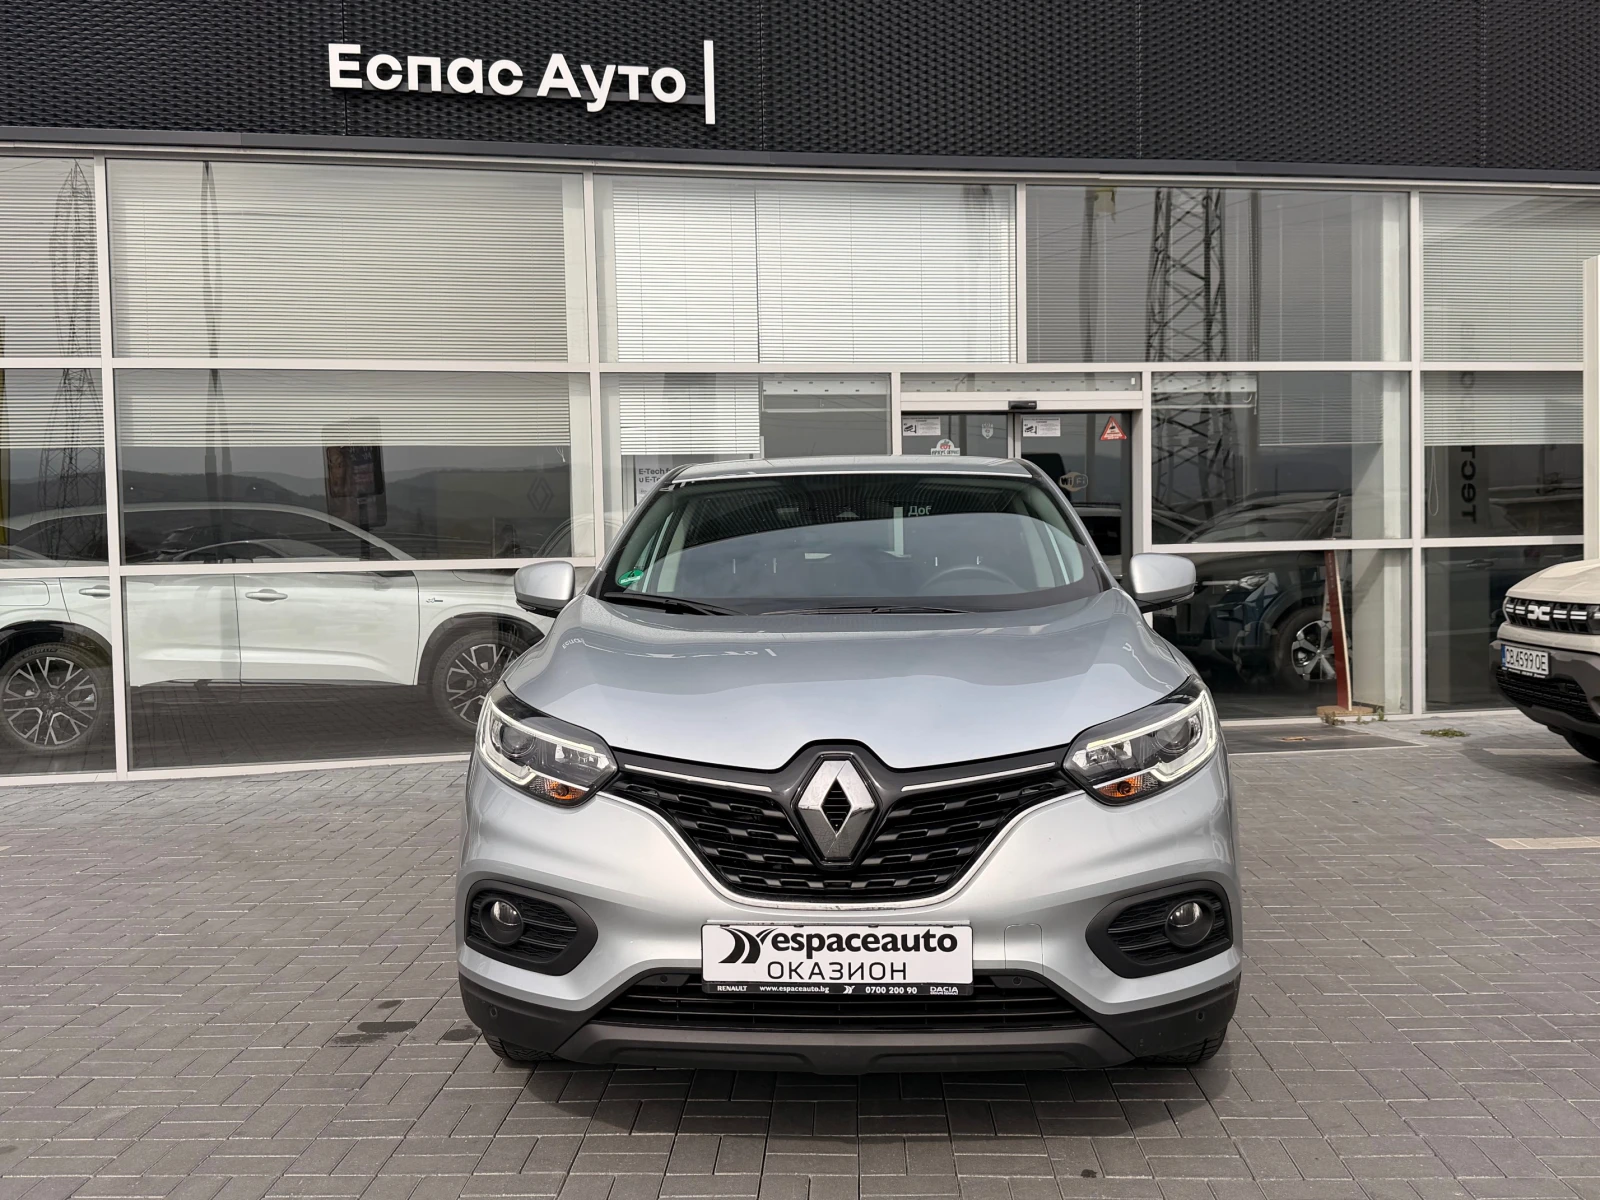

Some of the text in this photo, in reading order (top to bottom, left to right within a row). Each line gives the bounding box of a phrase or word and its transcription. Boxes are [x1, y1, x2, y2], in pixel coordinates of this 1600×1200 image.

[328, 43, 686, 112] Еспас Ауто
[638, 467, 665, 475] E-Tech
[1516, 651, 1534, 669] 4599
[771, 928, 958, 959] espaceauto
[767, 961, 907, 981] ОКАЗИОН
[759, 985, 830, 994] www.espaceauto.bg
[865, 986, 886, 994] 0700
[906, 987, 918, 995] 90
